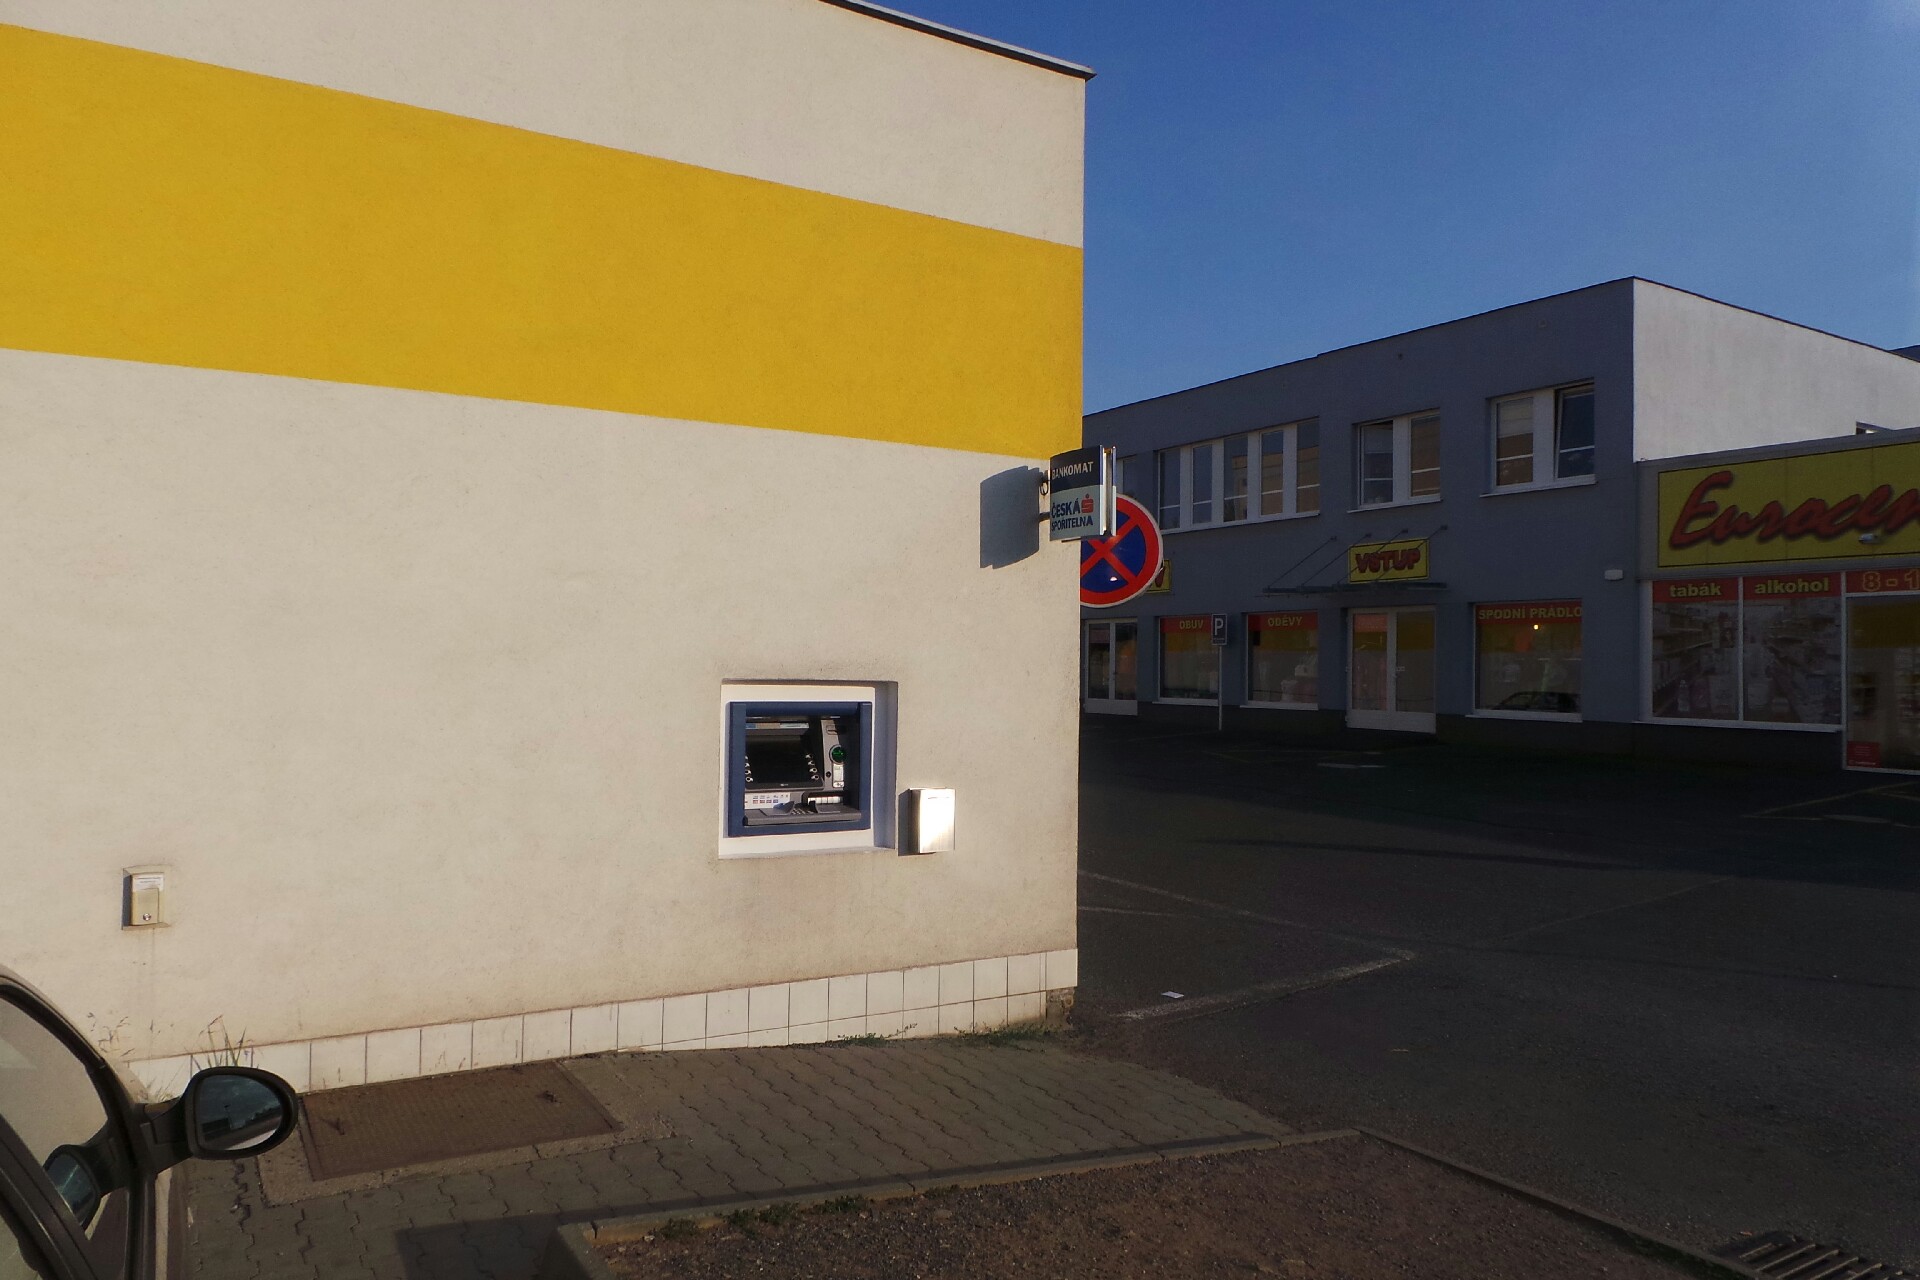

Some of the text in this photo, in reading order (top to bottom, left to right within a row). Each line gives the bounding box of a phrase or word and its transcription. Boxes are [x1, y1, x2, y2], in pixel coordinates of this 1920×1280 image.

[1051, 461, 1094, 481] BANKOMAT
[1051, 498, 1080, 518] ČESKÁ
[1355, 548, 1421, 573] VSTUP
[1669, 581, 1722, 598] tabák
[1754, 577, 1829, 595] alkohol
[1478, 606, 1526, 620] SPODNÍ
[1179, 619, 1204, 630] OBUV
[1214, 617, 1224, 636] P
